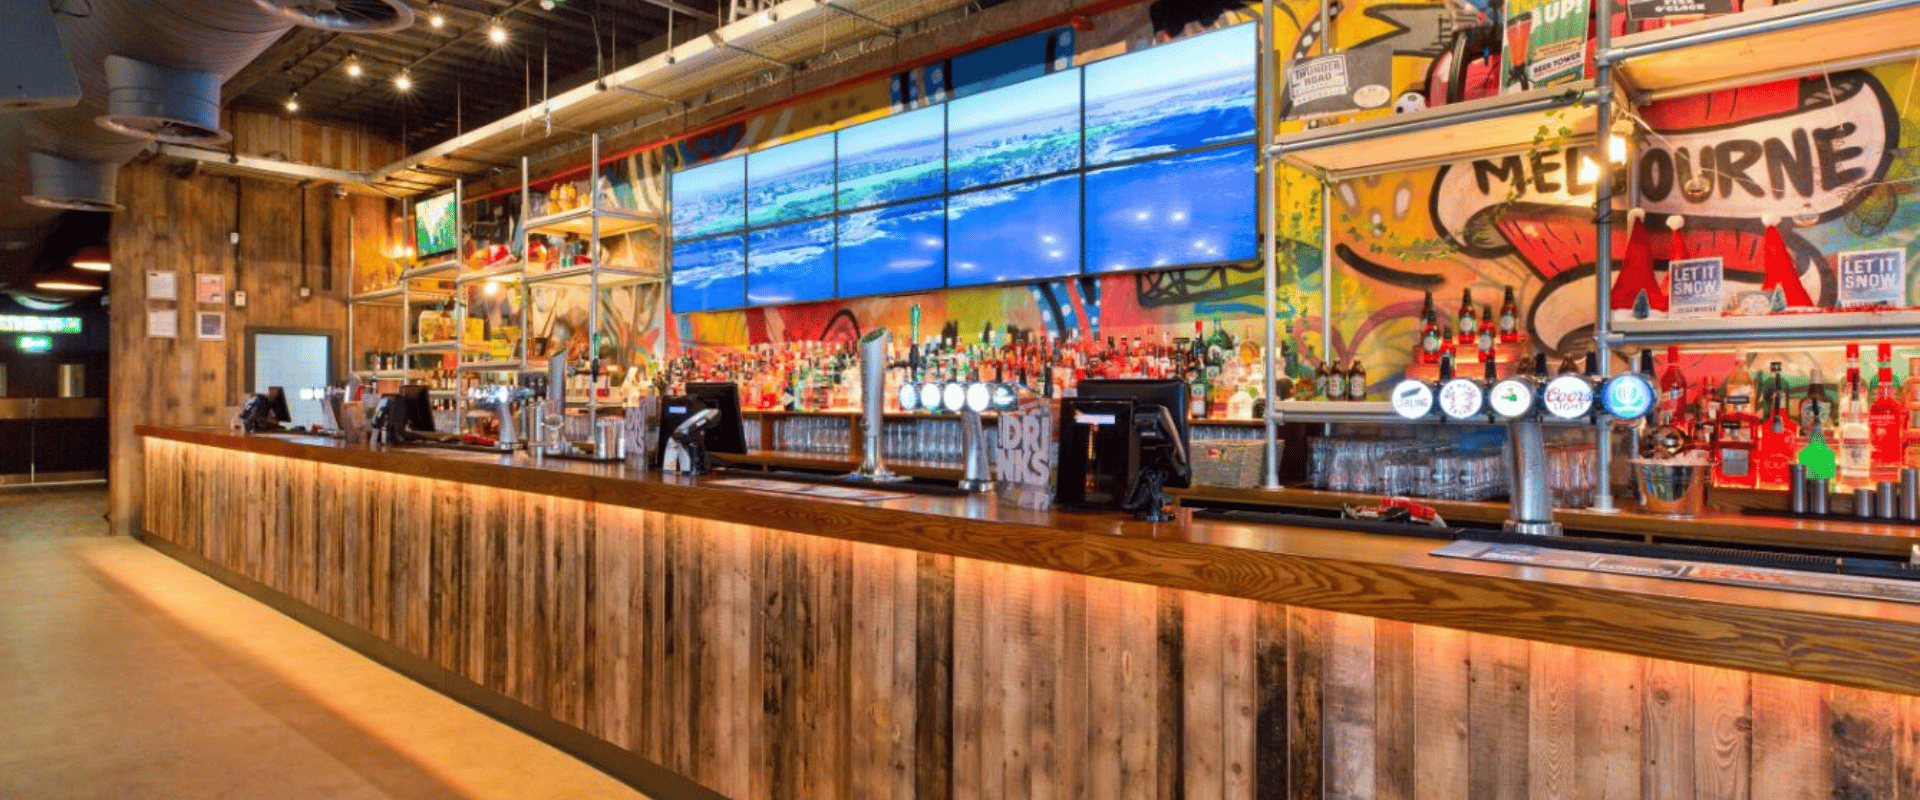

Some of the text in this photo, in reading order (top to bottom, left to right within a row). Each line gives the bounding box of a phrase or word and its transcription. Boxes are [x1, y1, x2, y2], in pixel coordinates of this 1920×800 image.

[1294, 60, 1341, 80] THUNDER
[1533, 51, 1581, 73] BEER TOWER
[1303, 72, 1332, 86] ROAD
[1471, 122, 1868, 204] MELOURNE
[1673, 265, 1716, 281] LET IT
[1844, 257, 1895, 275] LET IT
[1673, 281, 1717, 296] SNOW
[1844, 273, 1897, 289] SNOW
[1553, 403, 1584, 411] LIGHT
